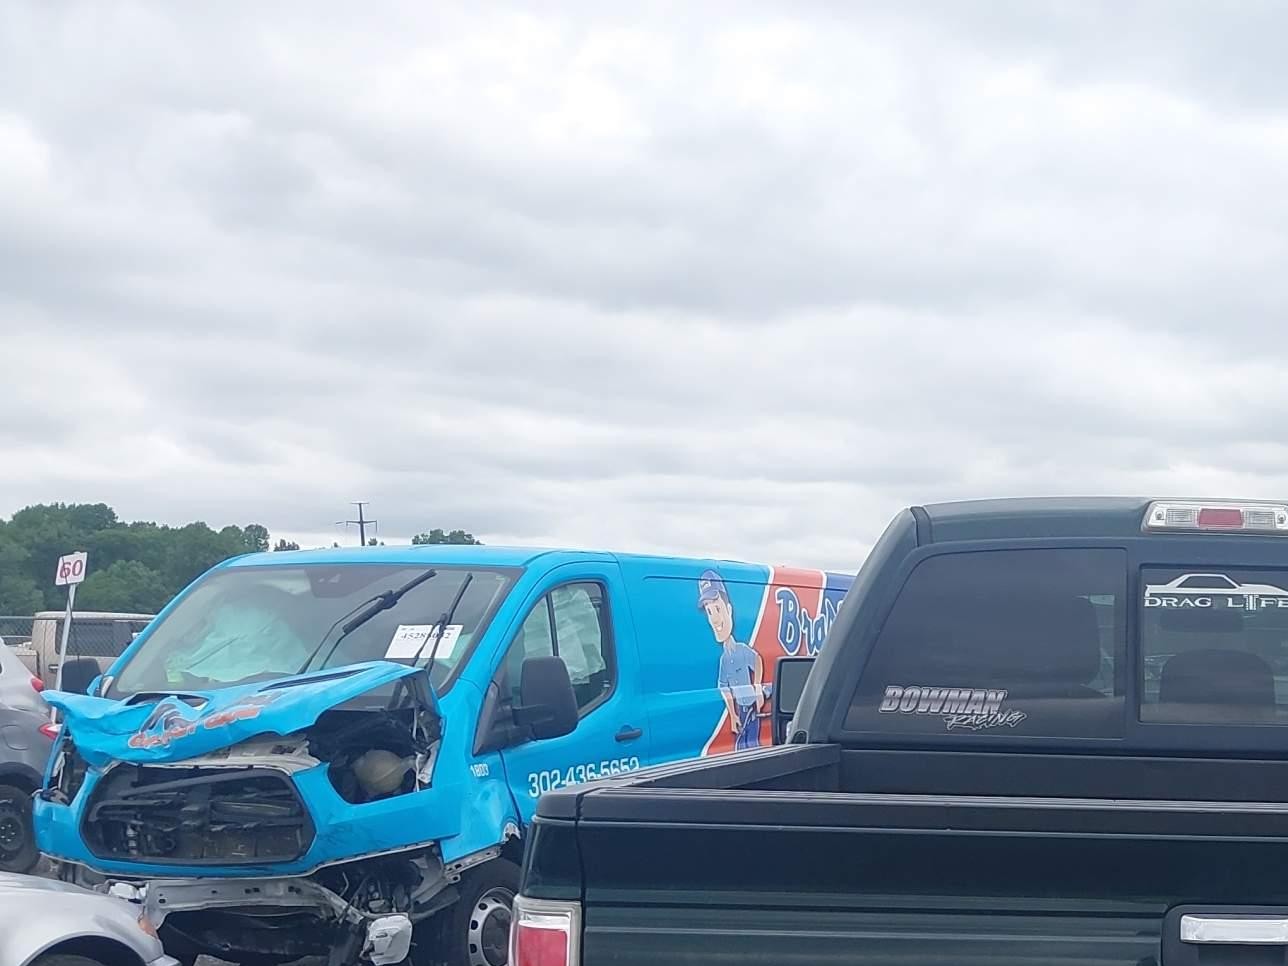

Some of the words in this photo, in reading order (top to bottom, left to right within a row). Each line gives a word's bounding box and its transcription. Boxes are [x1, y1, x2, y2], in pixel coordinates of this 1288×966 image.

[60, 559, 83, 579] 60
[1144, 596, 1212, 608] DRAG
[879, 686, 1007, 714] BOWMAN
[944, 710, 1027, 730] RACING
